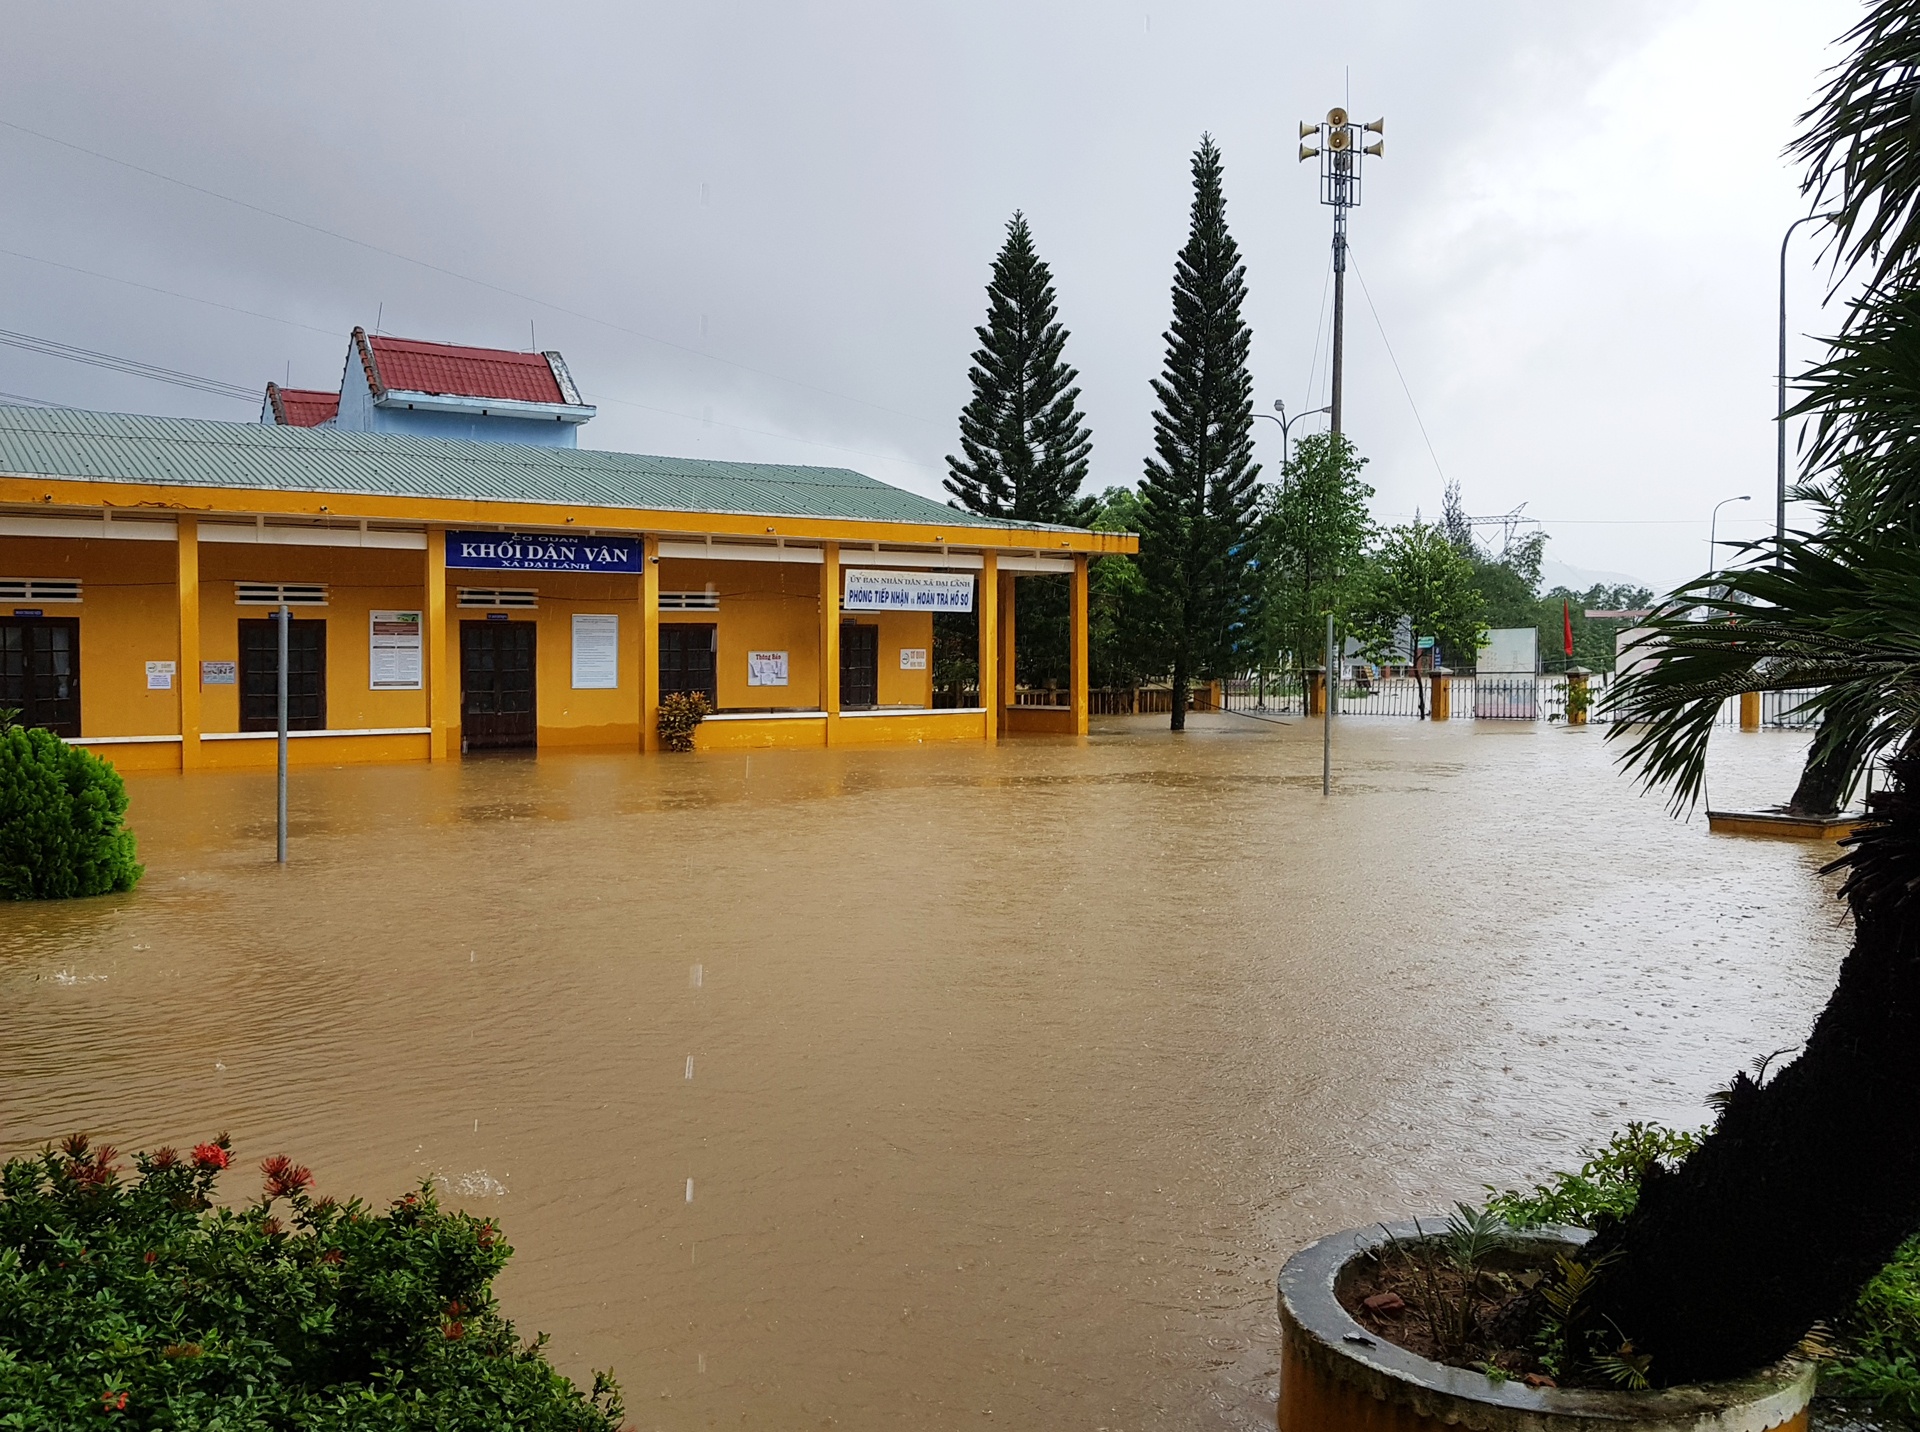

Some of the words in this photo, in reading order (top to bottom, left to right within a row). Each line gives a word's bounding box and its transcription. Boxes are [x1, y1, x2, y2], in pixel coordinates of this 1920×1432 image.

[460, 540, 523, 559] KHỐI
[527, 543, 577, 561] DÂN
[583, 545, 629, 565] VẬN
[881, 576, 904, 585] NHÂN
[905, 578, 922, 586] DÂN
[848, 586, 873, 603] PHÒNG
[874, 587, 890, 604] TIẾP
[890, 588, 909, 607] NHẬN
[916, 588, 936, 605] HOÀN
[936, 588, 949, 606] TRẢ
